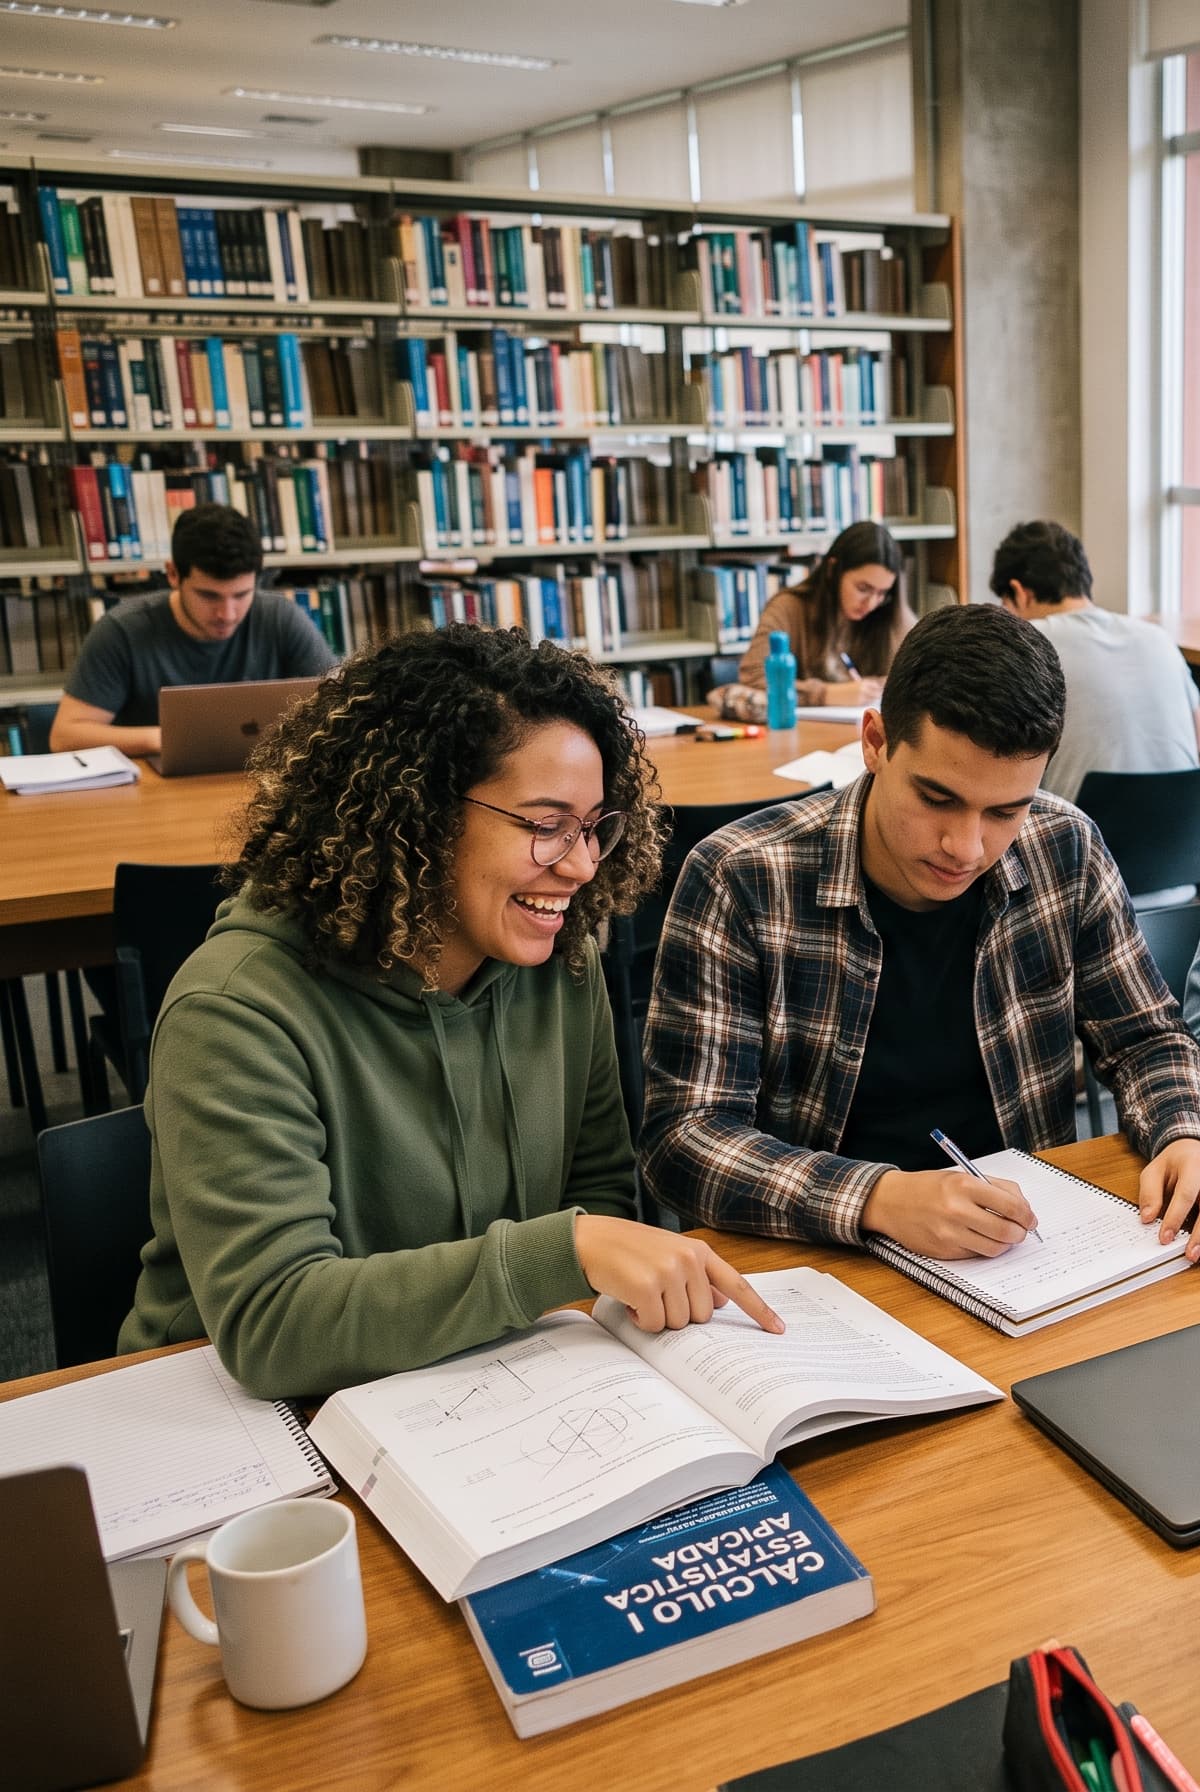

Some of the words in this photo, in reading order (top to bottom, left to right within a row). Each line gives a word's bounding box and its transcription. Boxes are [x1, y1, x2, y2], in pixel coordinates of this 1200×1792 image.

[604, 1529, 812, 1610] ESTATÍSTICA
[651, 1511, 791, 1571] APICADA
[653, 1550, 825, 1624] CÁLCULO
[627, 1612, 645, 1634] I
